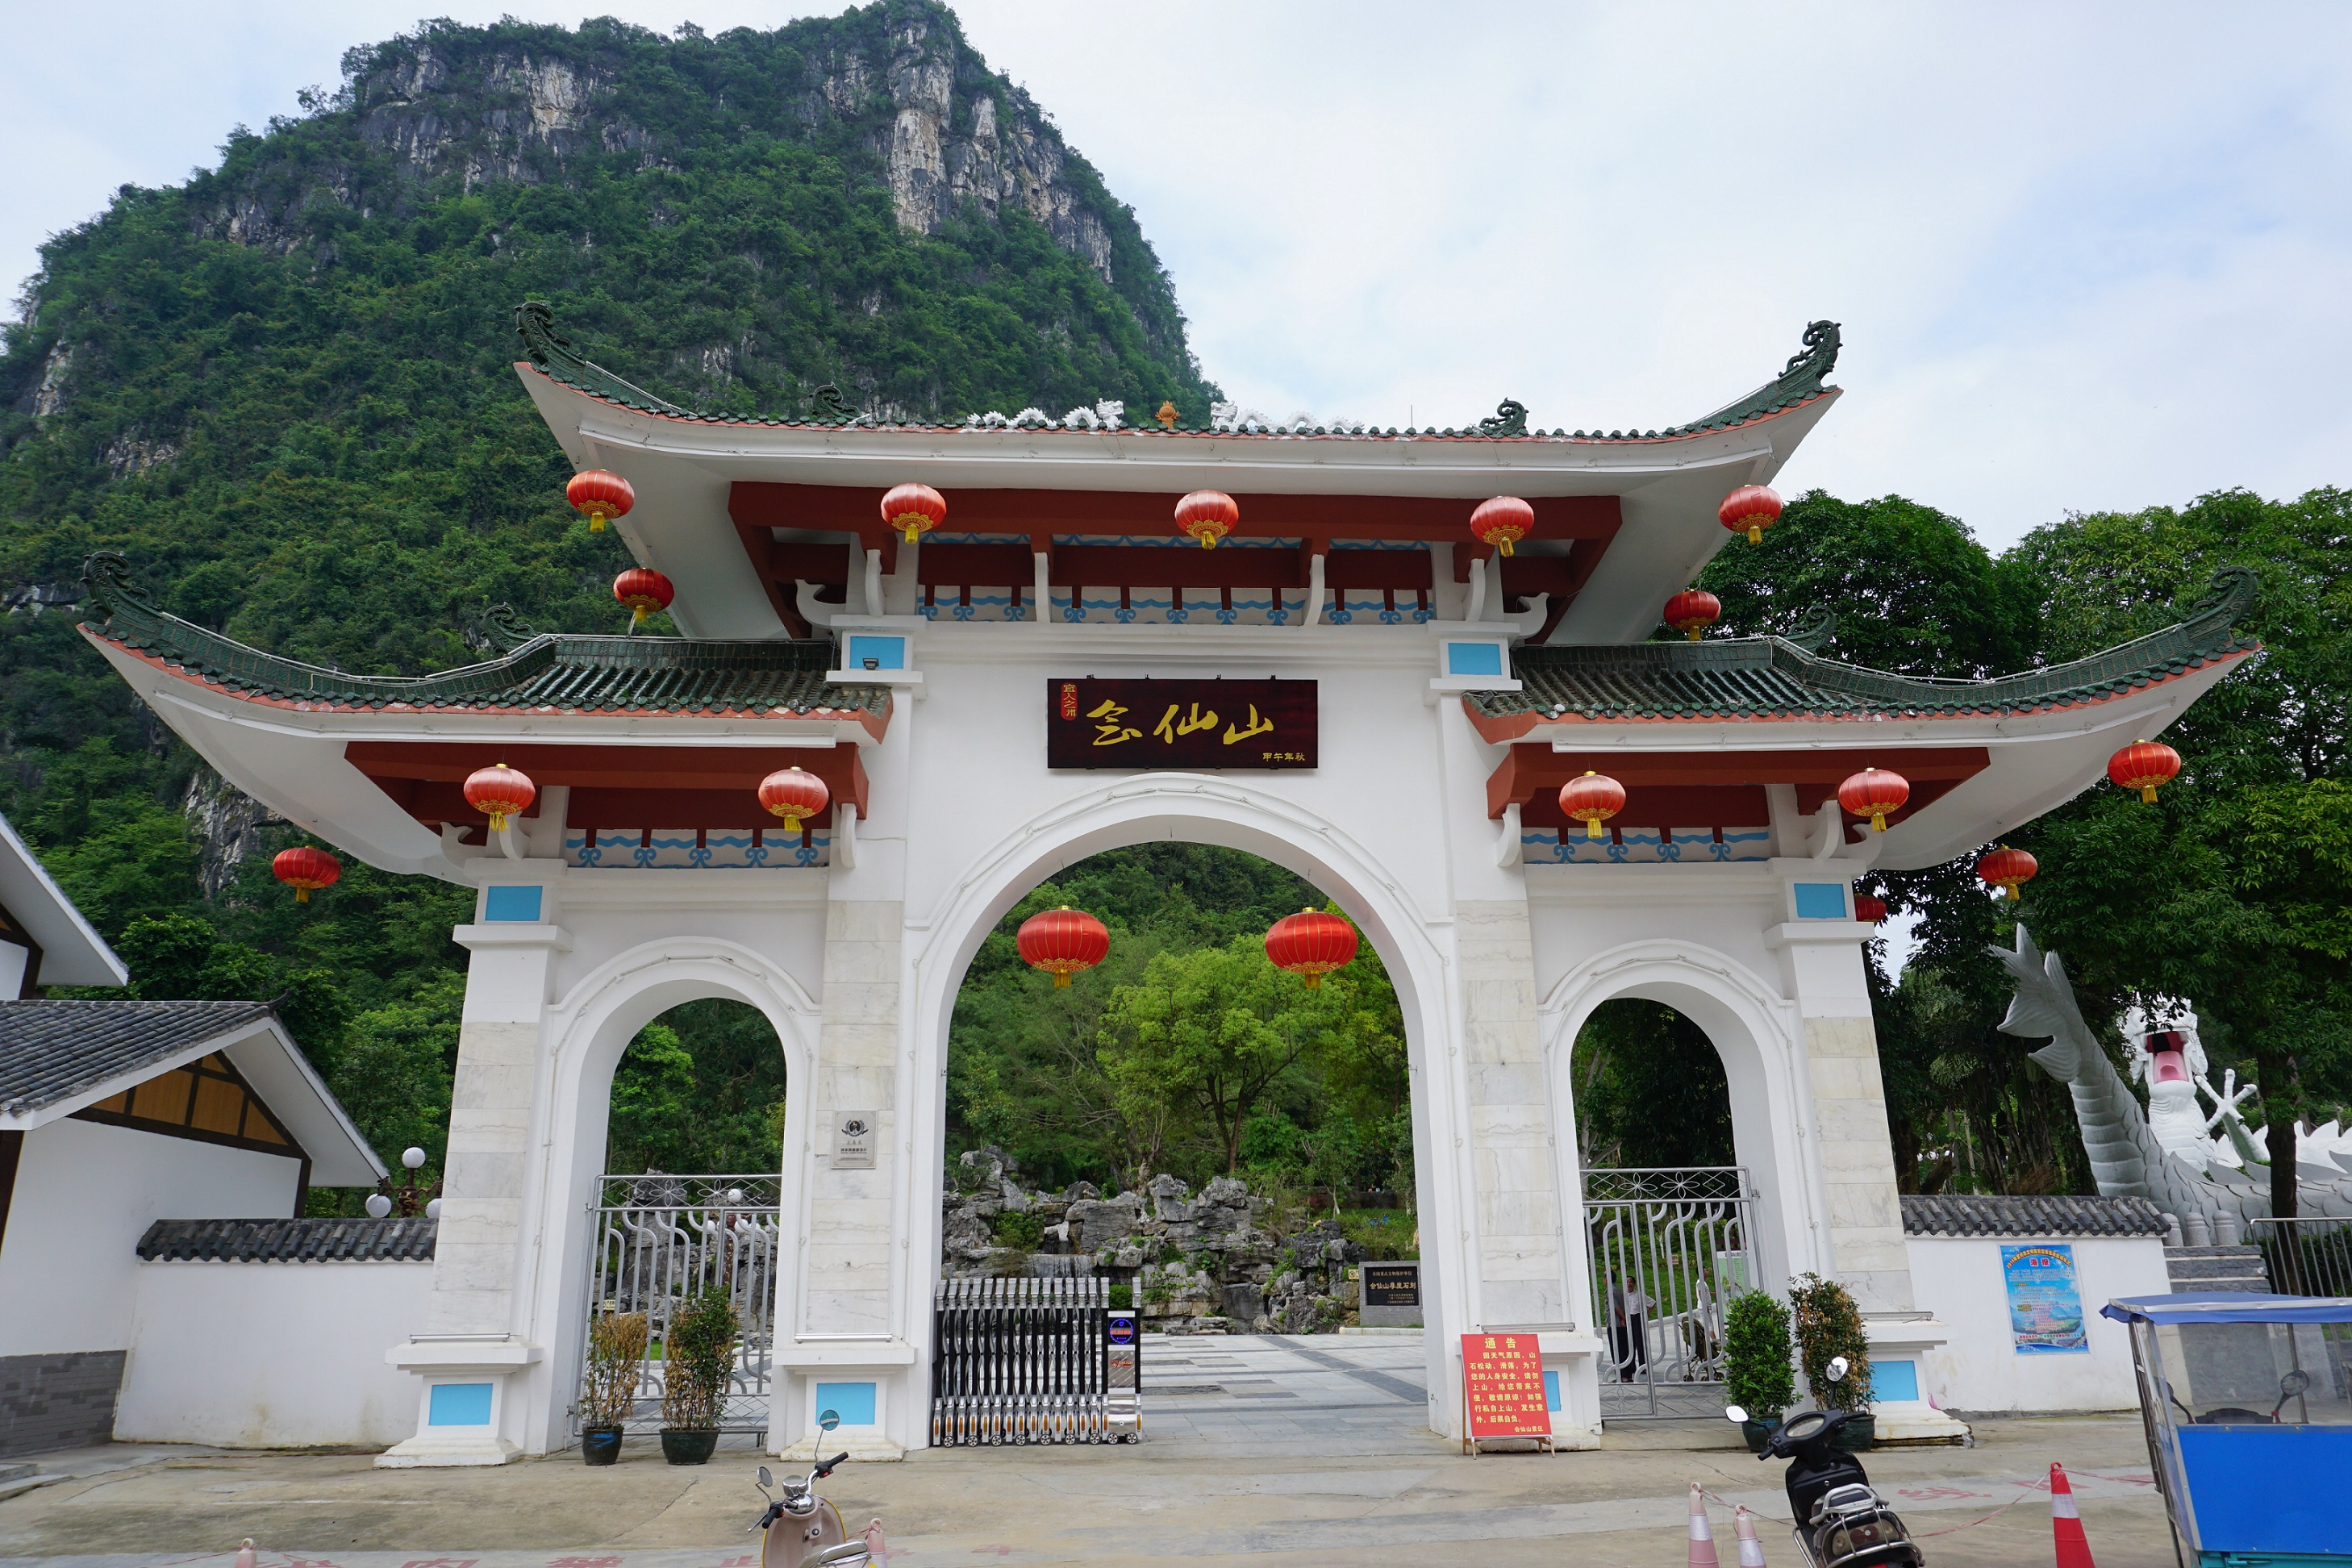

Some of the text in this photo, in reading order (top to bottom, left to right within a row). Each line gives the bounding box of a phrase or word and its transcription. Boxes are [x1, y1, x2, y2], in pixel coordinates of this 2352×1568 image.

[1063, 683, 1077, 717] 宜人之州
[1086, 699, 1274, 746] 会仙山
[1262, 752, 1306, 762] 甲午年秋
[1485, 1337, 1516, 1349] 通告
